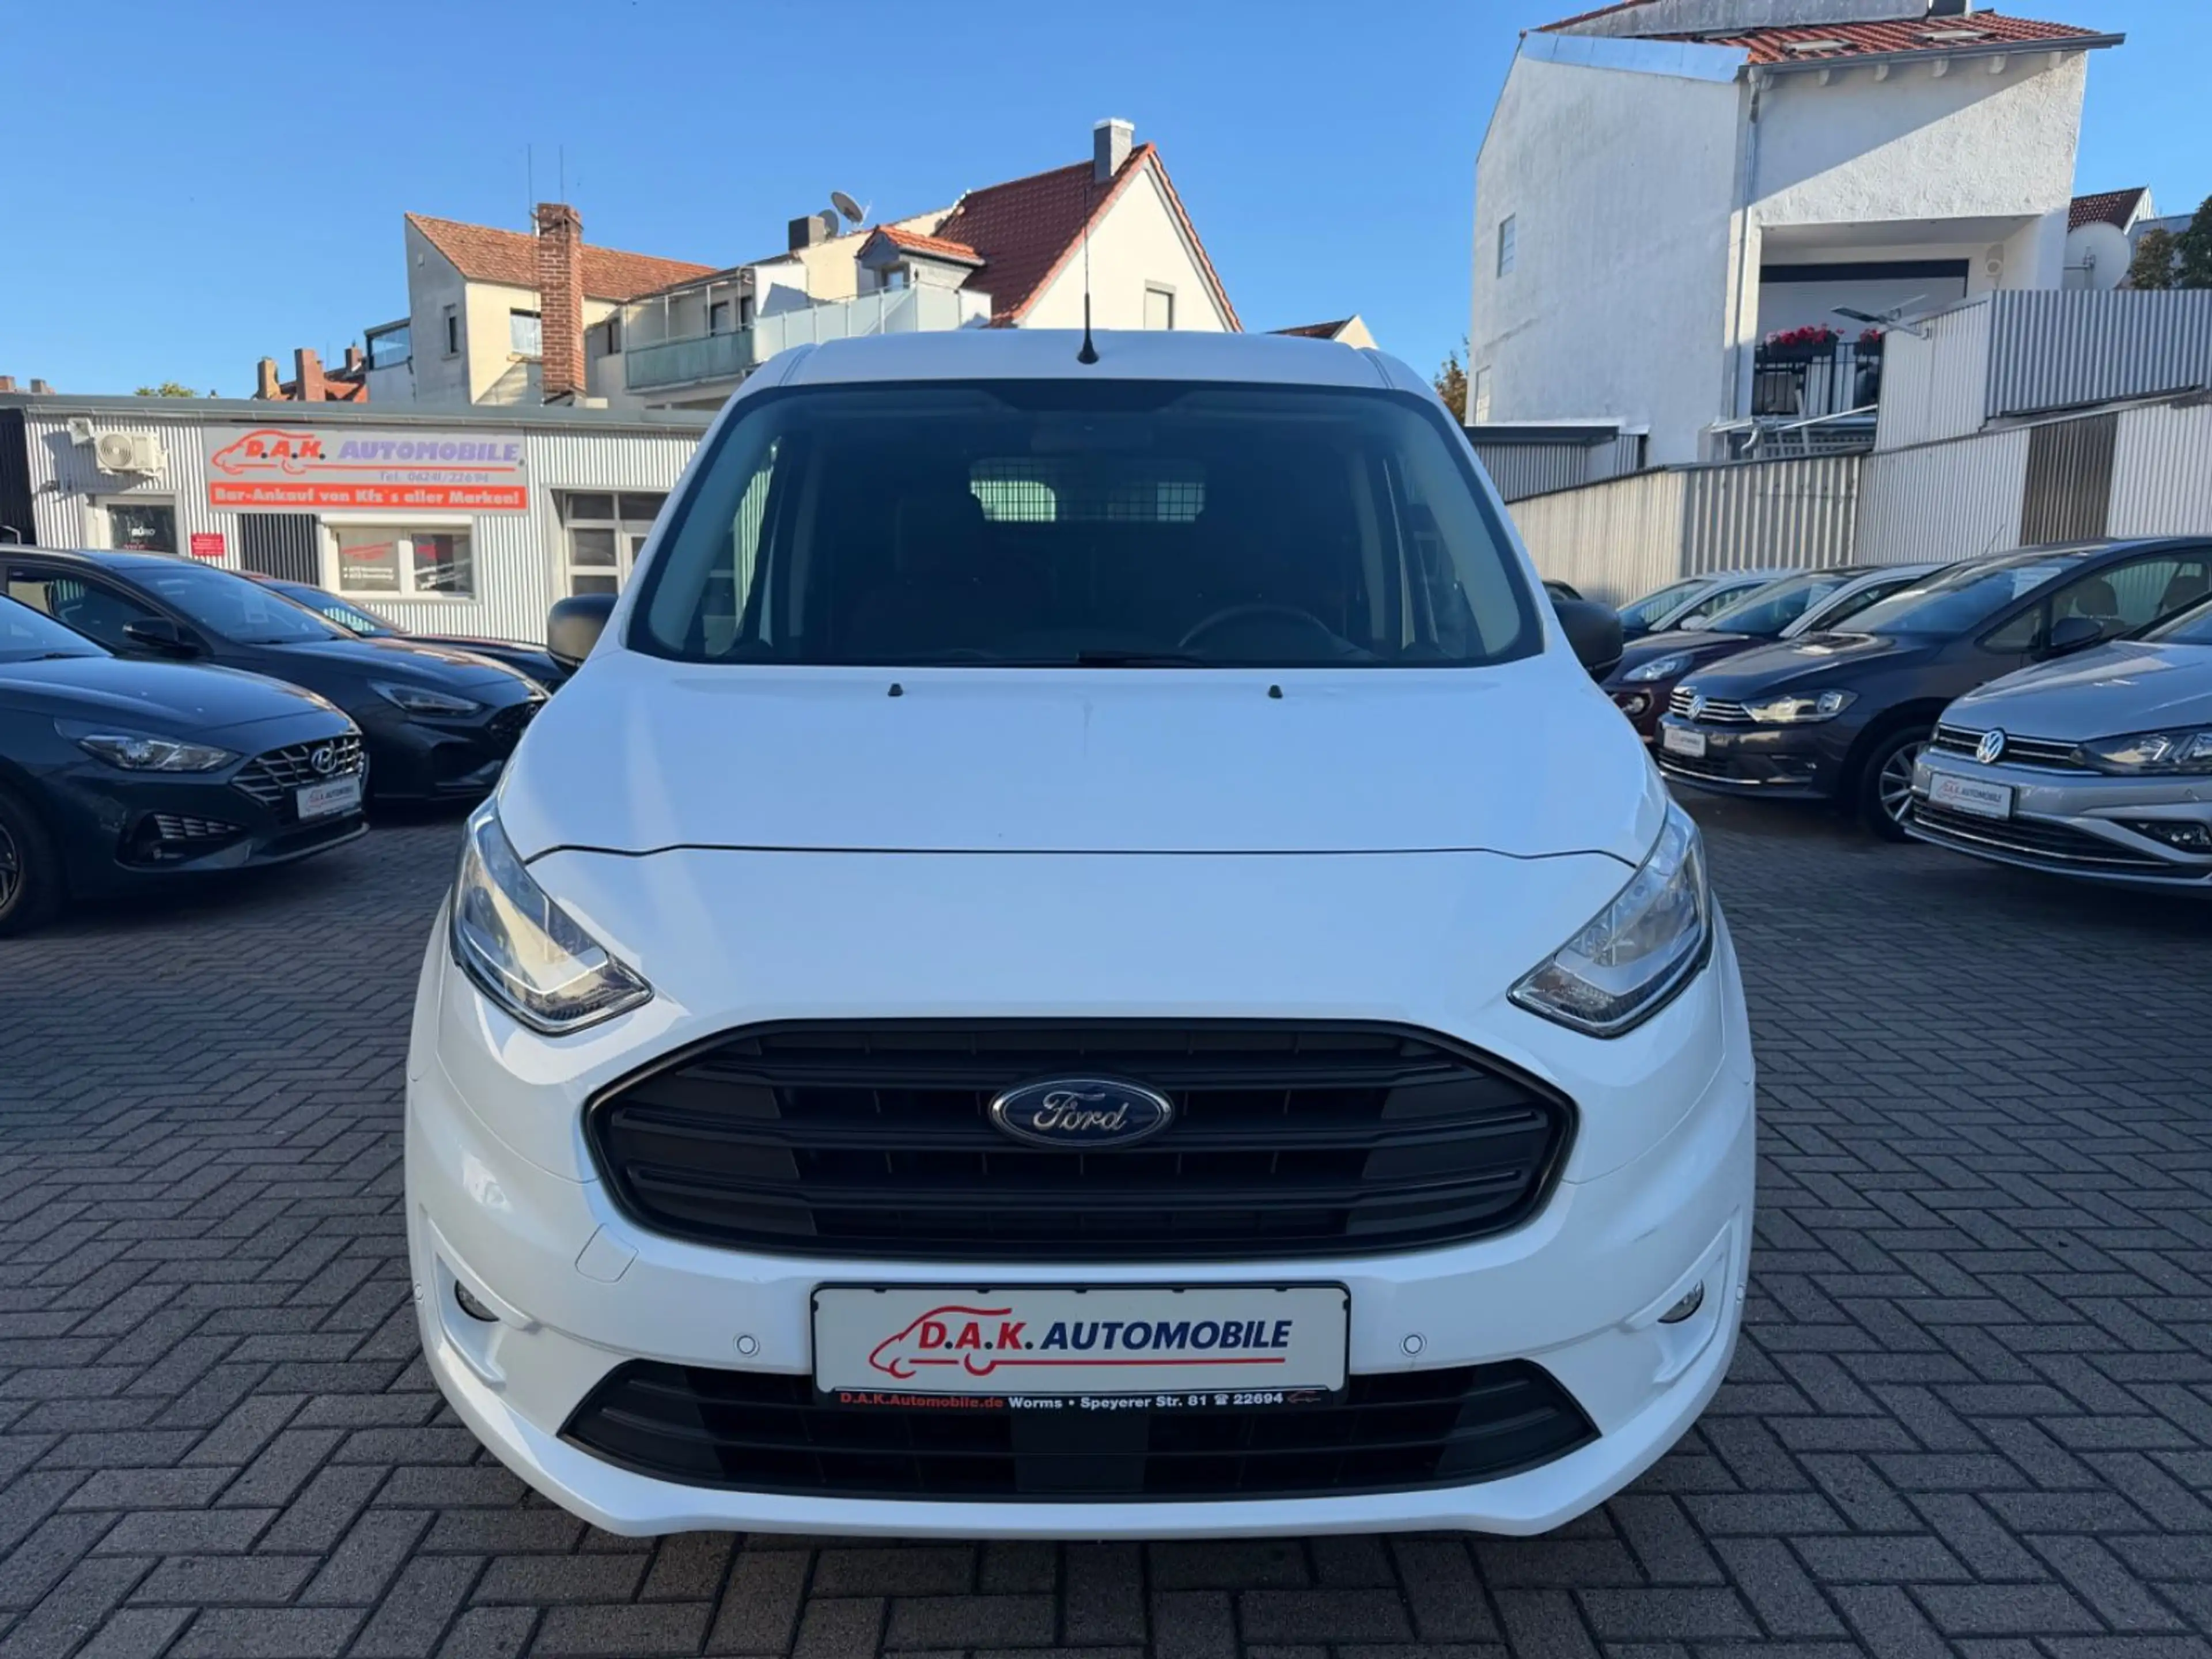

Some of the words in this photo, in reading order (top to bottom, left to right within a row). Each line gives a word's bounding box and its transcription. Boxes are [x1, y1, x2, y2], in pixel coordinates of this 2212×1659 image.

[215, 488, 315, 501] Bar-Ankauf
[319, 493, 350, 502] von
[404, 490, 444, 505] aller
[449, 490, 520, 506] Marken!
[1033, 1090, 1130, 1131] Ford
[1039, 1320, 1293, 1350] AUTOMOBILE
[1008, 1396, 1063, 1409] Worms
[1080, 1396, 1151, 1411] Speyerer
[1155, 1394, 1183, 1407] Str.
[1187, 1394, 1207, 1406] 81
